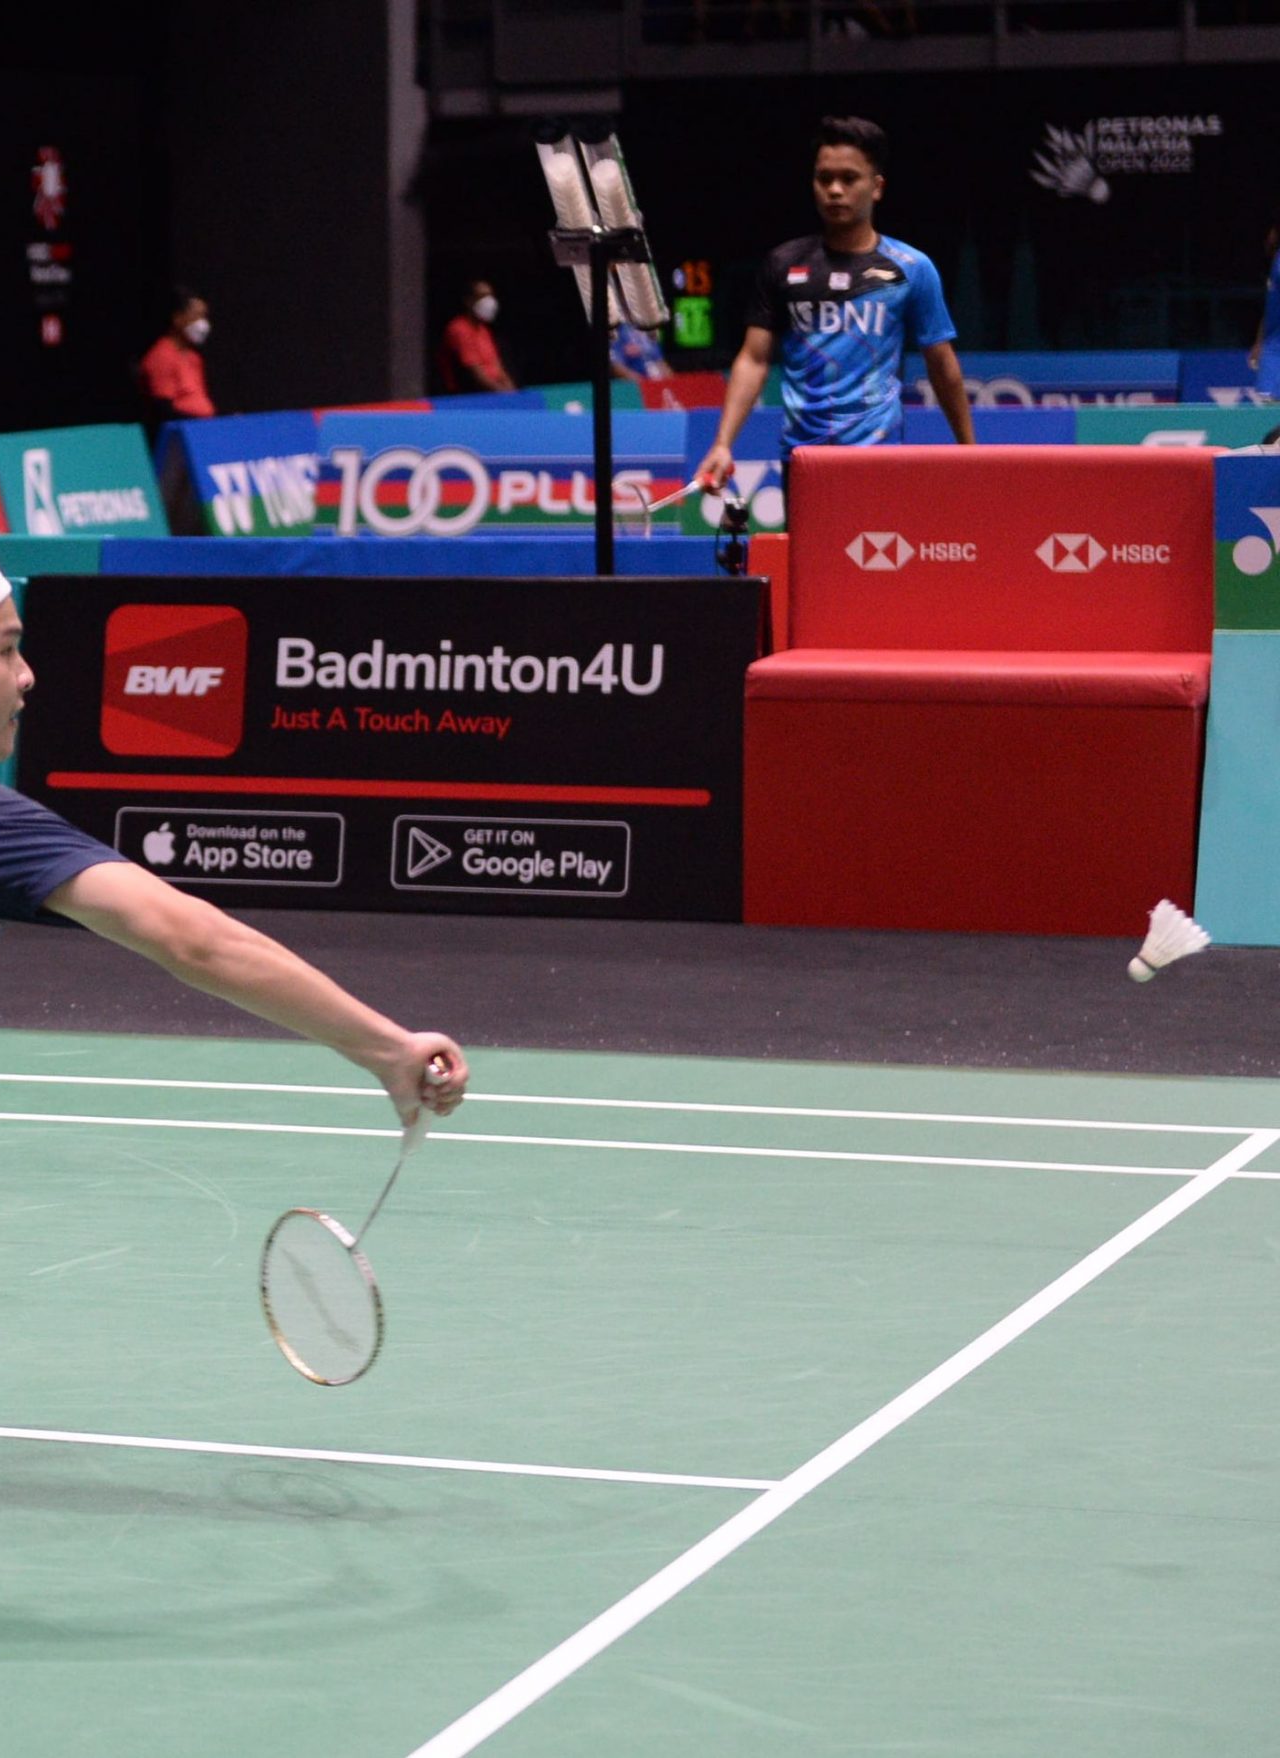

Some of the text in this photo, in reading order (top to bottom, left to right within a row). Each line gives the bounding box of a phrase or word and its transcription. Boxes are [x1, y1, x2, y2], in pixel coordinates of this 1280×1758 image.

[1097, 115, 1222, 135] PETRONAS
[1097, 135, 1192, 153] MALAYSIA
[1097, 151, 1193, 173] OPEN 2022
[819, 300, 886, 336] BNI
[919, 542, 977, 561] HSBC
[1112, 544, 1170, 563] HSBC
[275, 637, 664, 696] Badminton4U
[123, 665, 225, 695] BWF
[271, 706, 512, 740] Just A Touch Away
[186, 823, 306, 840] Download on the
[463, 828, 535, 846] GET IT ON
[183, 840, 313, 872] App Store
[462, 848, 612, 885] Google Play
